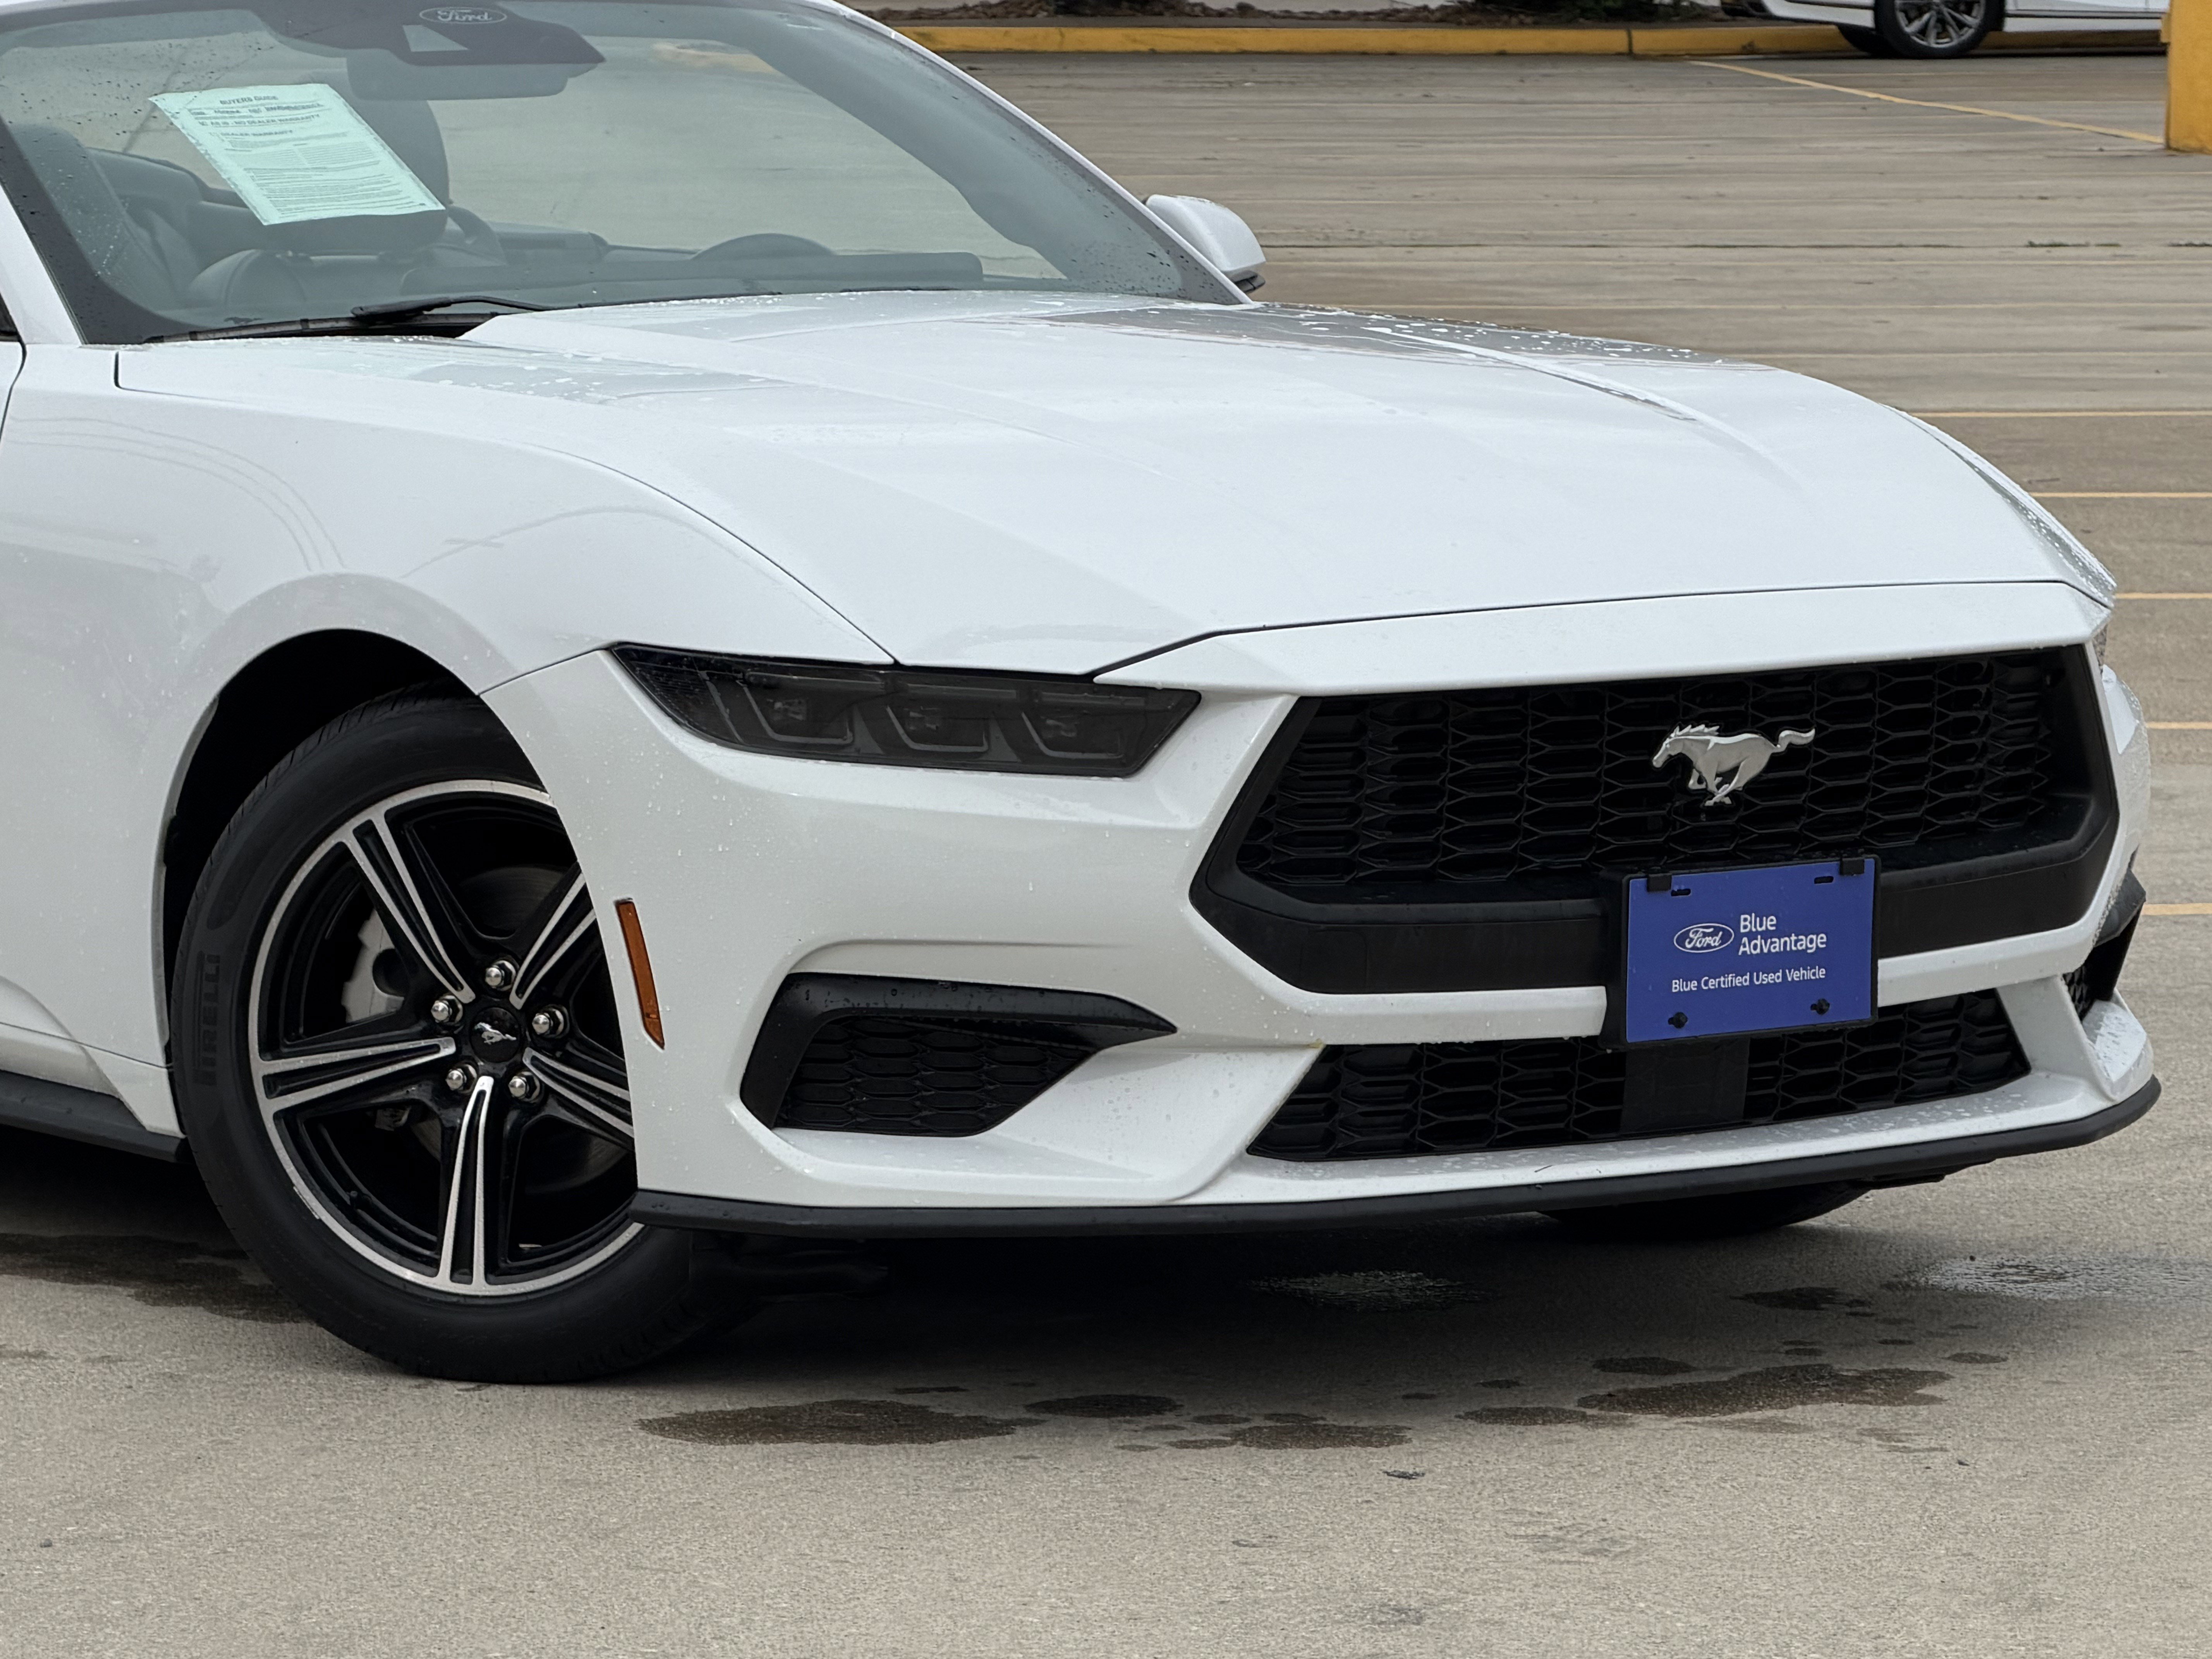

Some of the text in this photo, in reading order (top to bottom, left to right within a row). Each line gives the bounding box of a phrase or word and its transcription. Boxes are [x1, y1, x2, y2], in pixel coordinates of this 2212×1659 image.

[437, 9, 493, 21] Ford
[1740, 913, 1777, 933] Blue
[1685, 927, 1723, 948] Ford
[1738, 932, 1827, 956] Advantage
[1671, 965, 1826, 992] Blue Certified Used Vehicle
[193, 951, 220, 1086] PIRELLI
